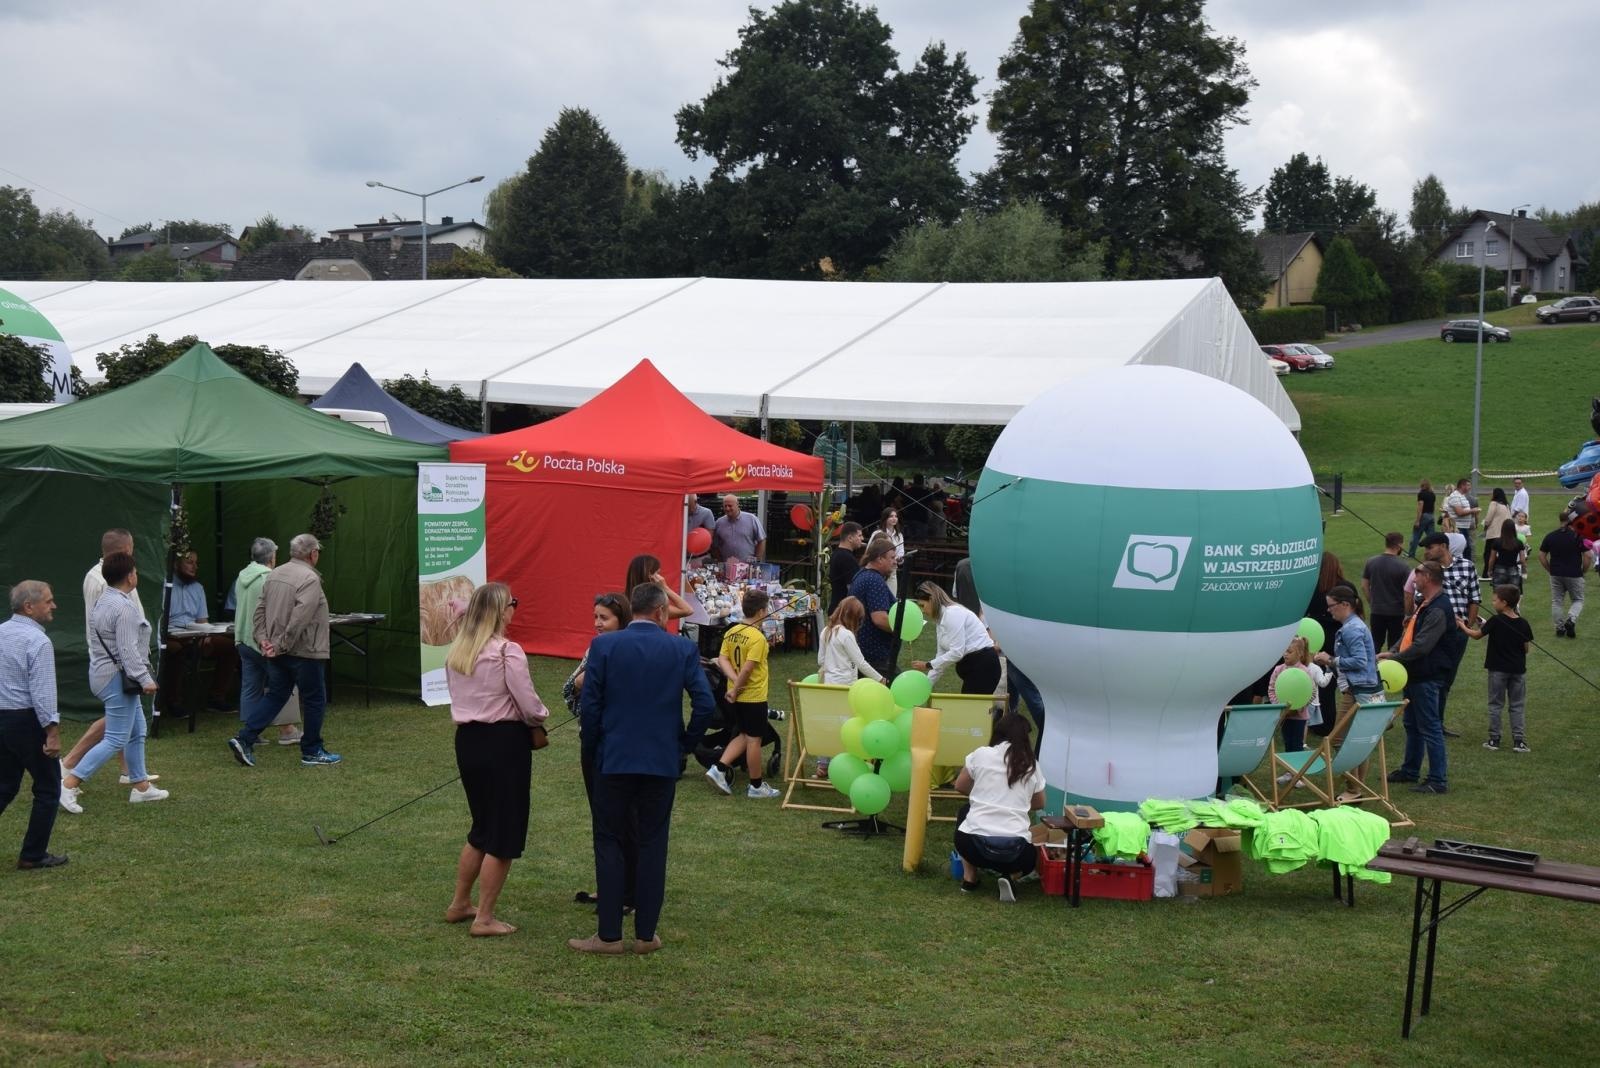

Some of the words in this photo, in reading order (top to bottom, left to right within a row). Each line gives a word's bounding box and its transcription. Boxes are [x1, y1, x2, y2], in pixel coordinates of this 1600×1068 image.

[543, 455, 583, 471] Poczta
[586, 458, 625, 475] Polska
[747, 463, 771, 478] Poczta
[771, 464, 794, 478] Polska
[1204, 544, 1244, 557] BANK
[1250, 537, 1319, 556] SPÓŁDZIELCZY
[1203, 562, 1218, 573] W
[1219, 558, 1293, 575] JASTRZĘBIU
[1292, 553, 1320, 569] ZDROJU
[1201, 581, 1252, 592] ZAŁOŻONY
[1253, 581, 1264, 590] W
[1265, 579, 1284, 590] 1897
